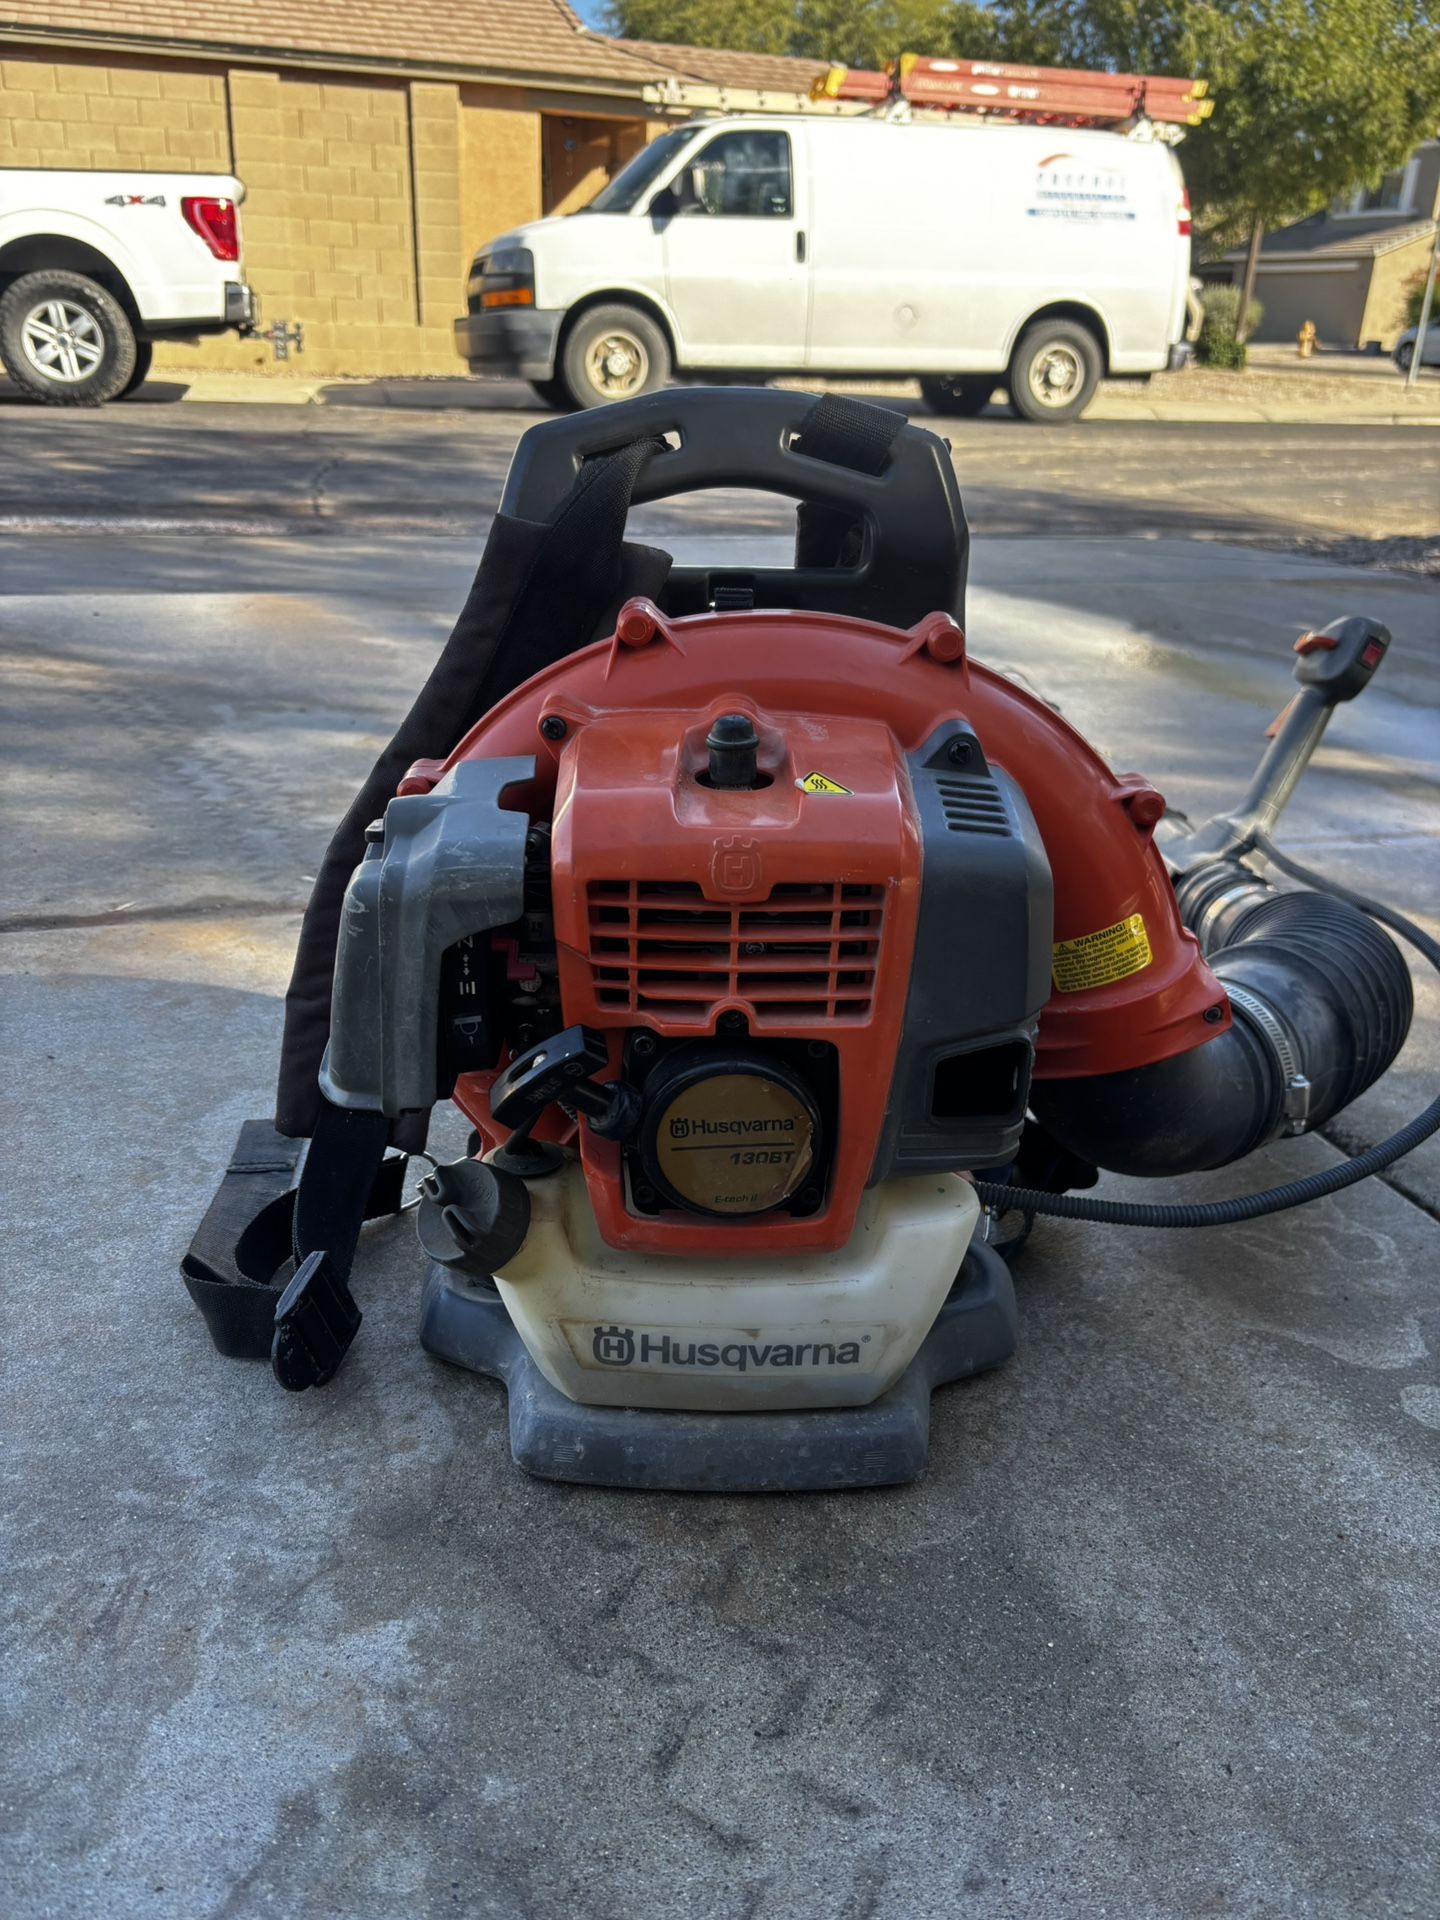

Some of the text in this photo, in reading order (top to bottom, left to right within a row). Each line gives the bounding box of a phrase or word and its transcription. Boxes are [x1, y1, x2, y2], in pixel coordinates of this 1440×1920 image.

[1073, 922, 1125, 947] WARNING!
[692, 1118, 794, 1135] Husqvarna
[640, 1334, 860, 1372] Husqvarna
